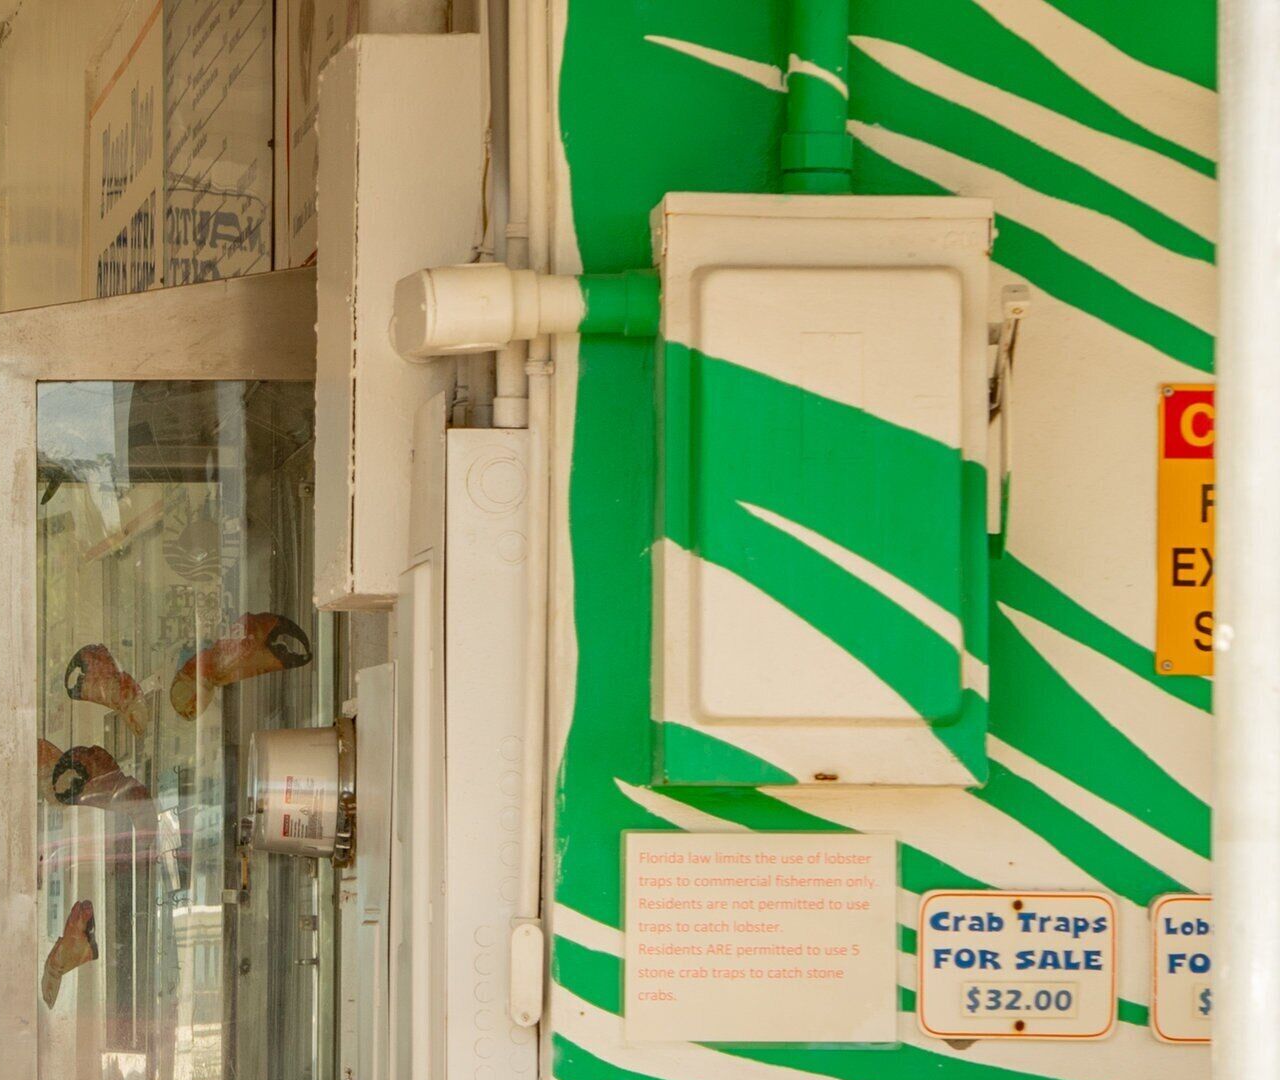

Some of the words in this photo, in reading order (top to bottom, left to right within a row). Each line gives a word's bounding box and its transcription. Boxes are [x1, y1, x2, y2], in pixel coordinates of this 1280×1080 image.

[639, 852, 684, 864] Florida
[689, 852, 711, 864] law
[715, 852, 752, 864] limits
[755, 852, 776, 864] the
[781, 855, 803, 864] use
[807, 852, 820, 864] of
[824, 852, 872, 864] lobster
[639, 876, 672, 889] traps
[676, 876, 690, 887] to
[694, 875, 771, 887] commercial
[776, 874, 842, 887] fishermen
[846, 875, 879, 889] only.
[638, 897, 703, 910] Residents
[706, 900, 728, 910] are
[732, 898, 754, 910] not
[758, 898, 825, 913] permitted
[829, 898, 842, 910] to
[846, 900, 870, 910] use
[639, 921, 672, 934] traps
[676, 921, 690, 932] to
[694, 920, 729, 932] catch
[734, 920, 784, 933] lobster.
[929, 911, 1004, 932] Crab
[1017, 912, 1107, 938] Traps
[638, 943, 703, 956] Residents
[706, 944, 733, 956] ARE
[736, 943, 802, 958] permitted
[806, 945, 820, 956] to
[824, 946, 847, 956] use
[852, 944, 860, 956] 5
[933, 949, 1002, 970] FOR
[1015, 950, 1103, 971] SALE
[1167, 953, 1211, 974] FO
[638, 967, 675, 979] stone
[679, 966, 707, 979] crab
[711, 967, 745, 981] traps
[749, 967, 764, 979] to
[767, 966, 803, 979] catch
[807, 968, 844, 979] stone
[638, 989, 677, 1001] crabs.
[966, 986, 1072, 1013] $32.00
